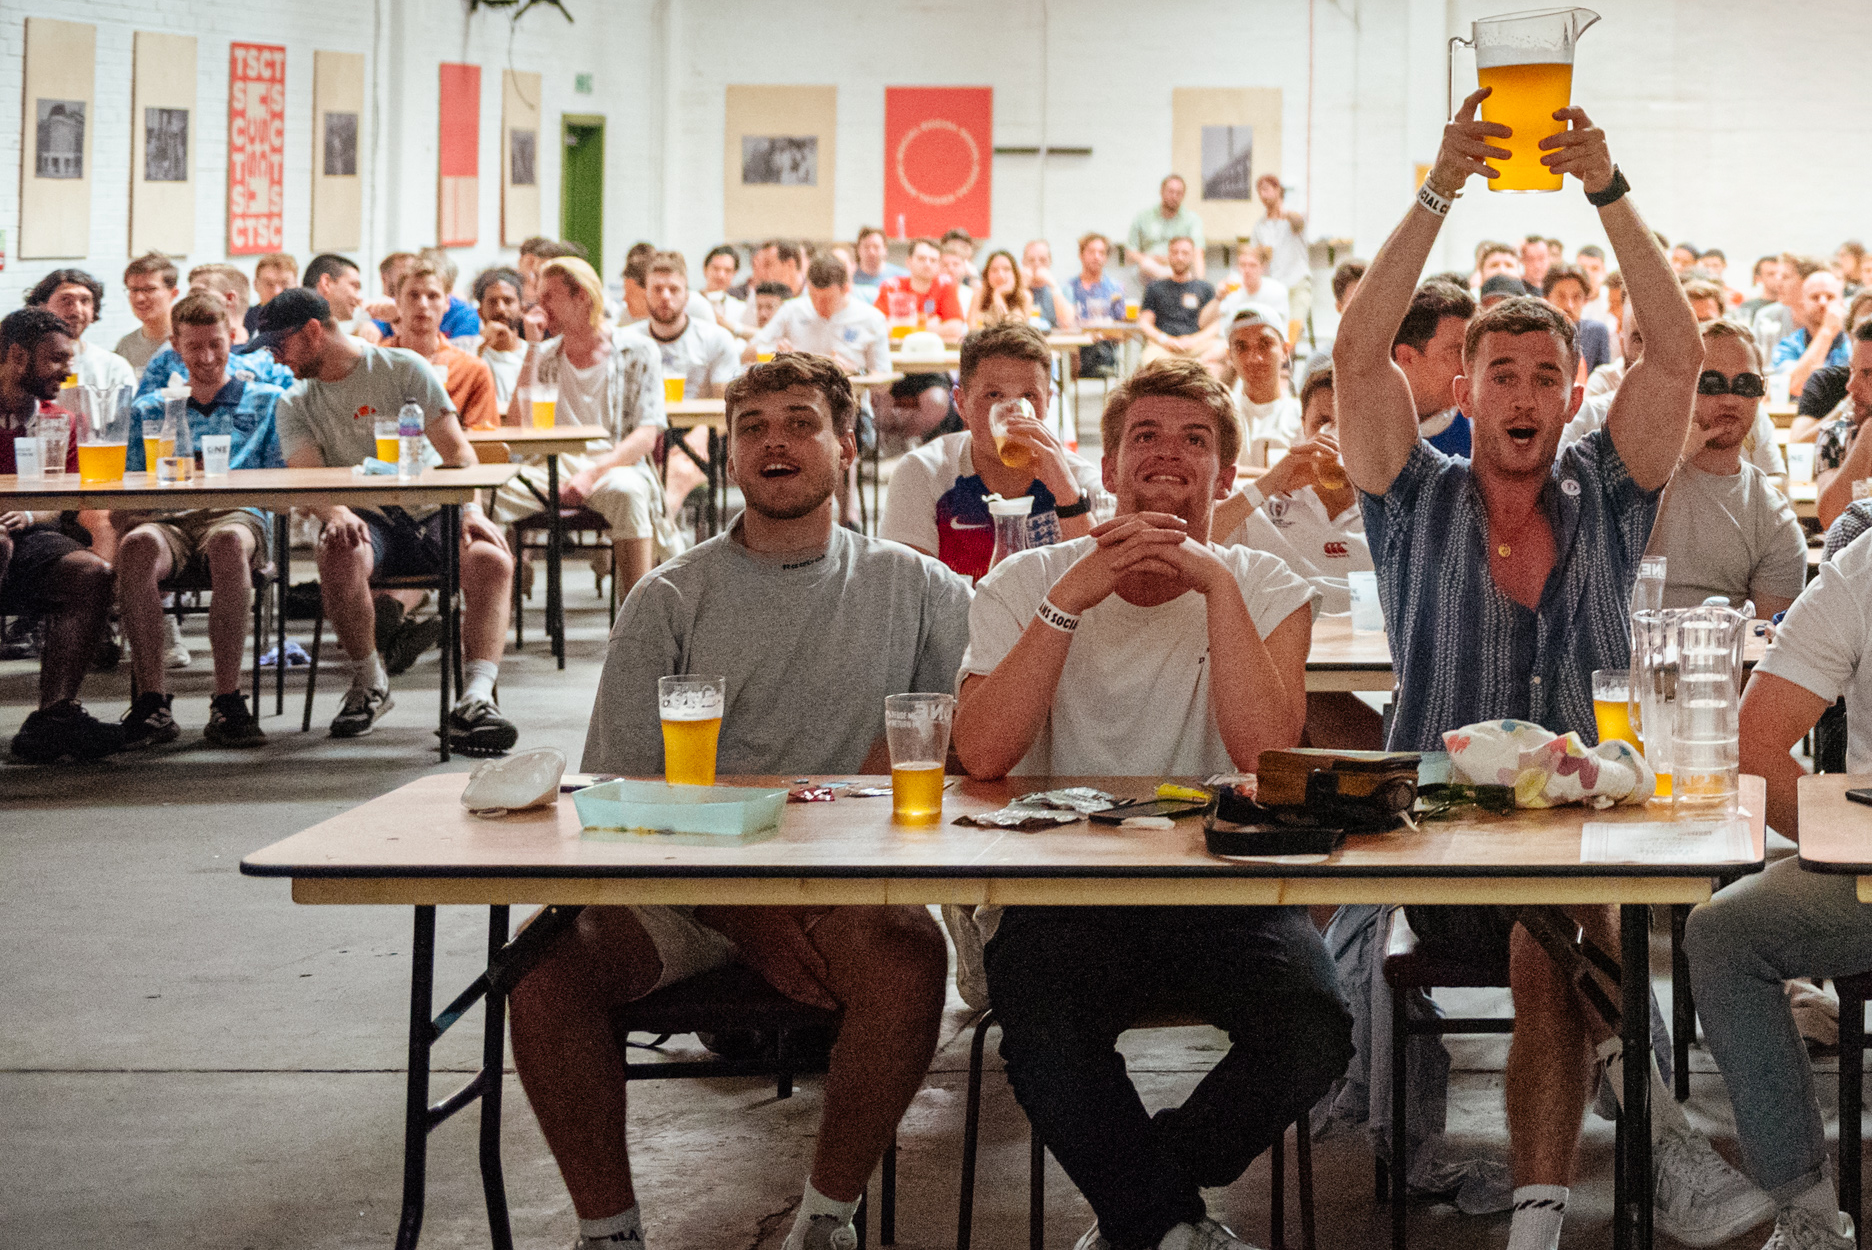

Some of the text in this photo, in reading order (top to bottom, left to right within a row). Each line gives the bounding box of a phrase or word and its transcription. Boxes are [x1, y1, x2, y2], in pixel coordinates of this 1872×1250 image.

[234, 48, 284, 79] TSCT
[1419, 187, 1440, 211] CIAL
[232, 218, 282, 247] CTSC
